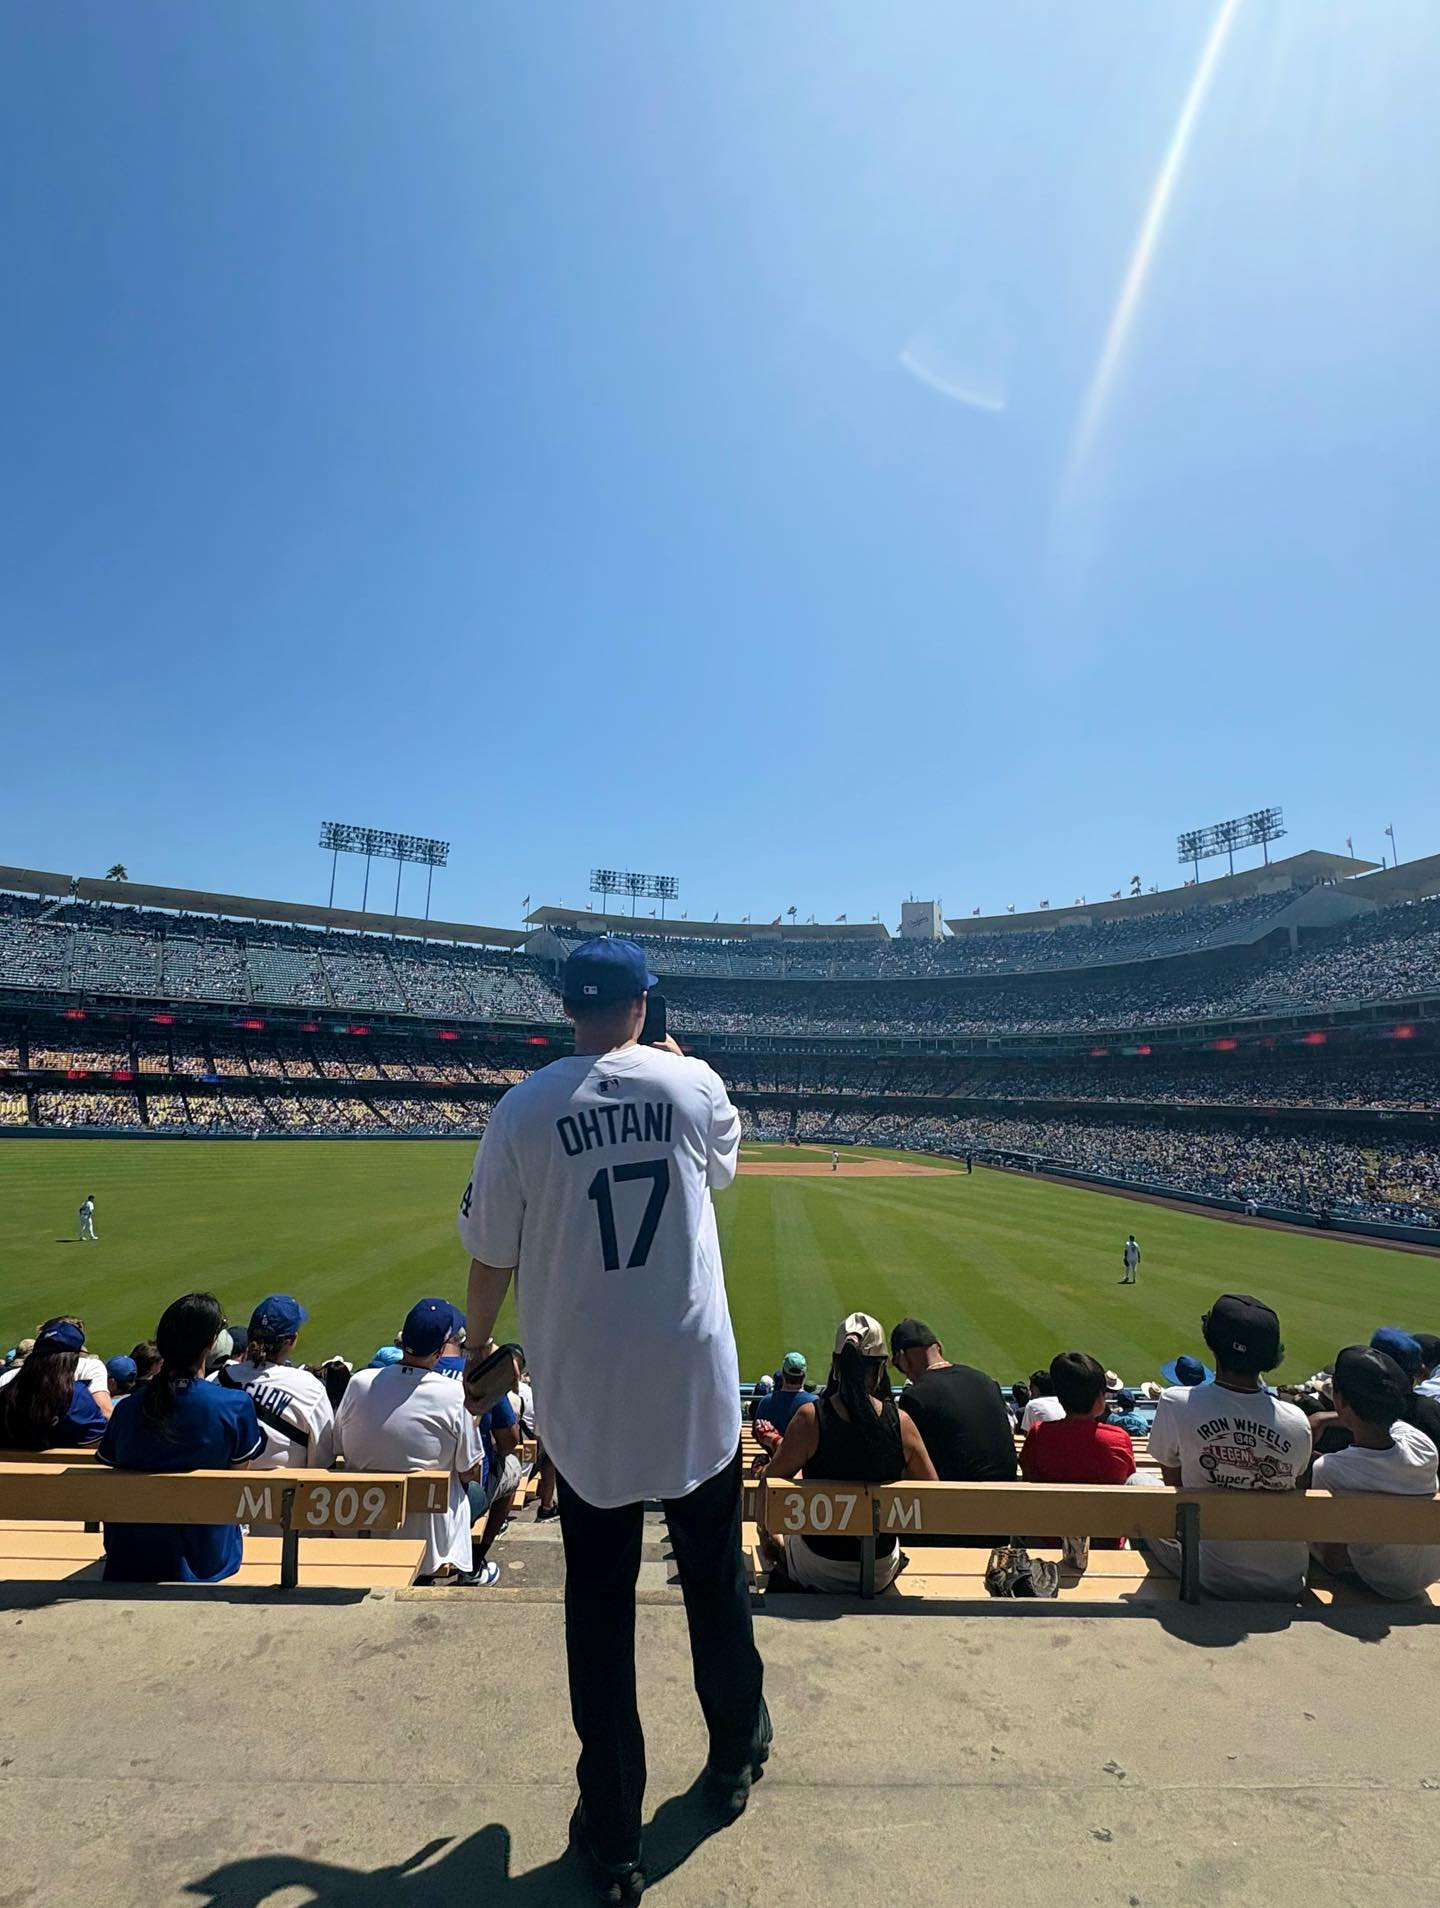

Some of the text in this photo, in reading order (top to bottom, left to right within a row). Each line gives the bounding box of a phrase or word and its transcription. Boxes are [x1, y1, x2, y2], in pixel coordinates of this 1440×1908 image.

[556, 1103, 673, 1156] OHTANI
[588, 1158, 670, 1272] 17
[1197, 1417, 1291, 1454] IRON WHEELS
[1234, 1433, 1255, 1446] 1946
[1206, 1468, 1250, 1488] Super
[236, 1486, 272, 1520] M
[306, 1486, 386, 1526] 309
[783, 1493, 857, 1530] 307
[887, 1497, 922, 1530] M
